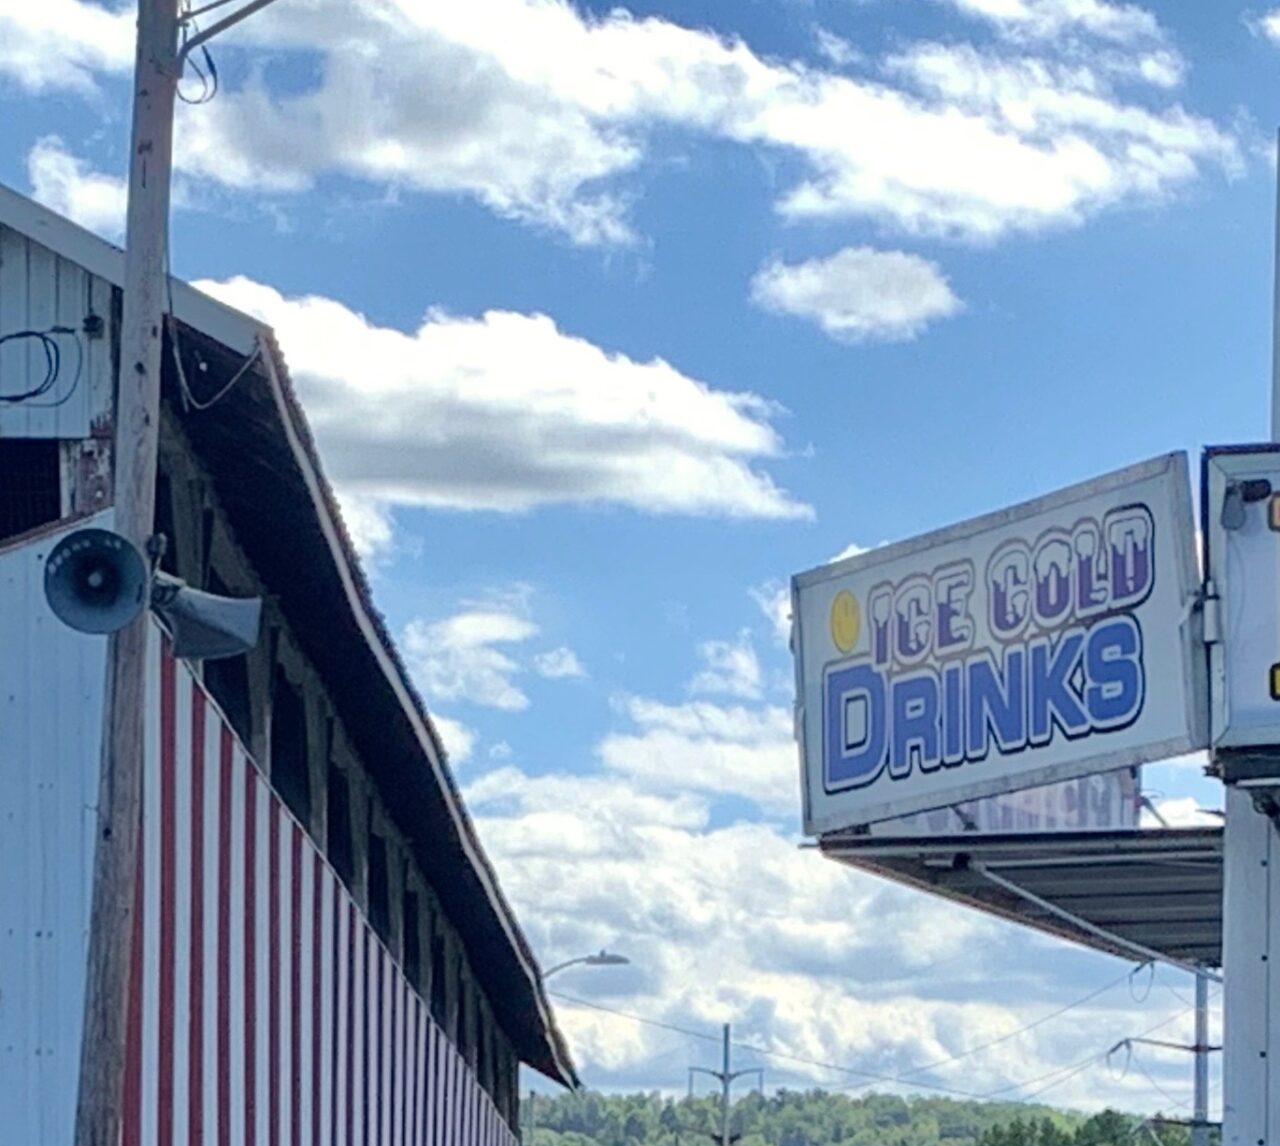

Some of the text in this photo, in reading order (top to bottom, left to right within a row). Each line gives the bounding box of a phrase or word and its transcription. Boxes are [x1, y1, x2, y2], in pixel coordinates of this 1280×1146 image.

[868, 503, 1155, 665] ICE COLD
[822, 610, 1145, 795] DRINKS
